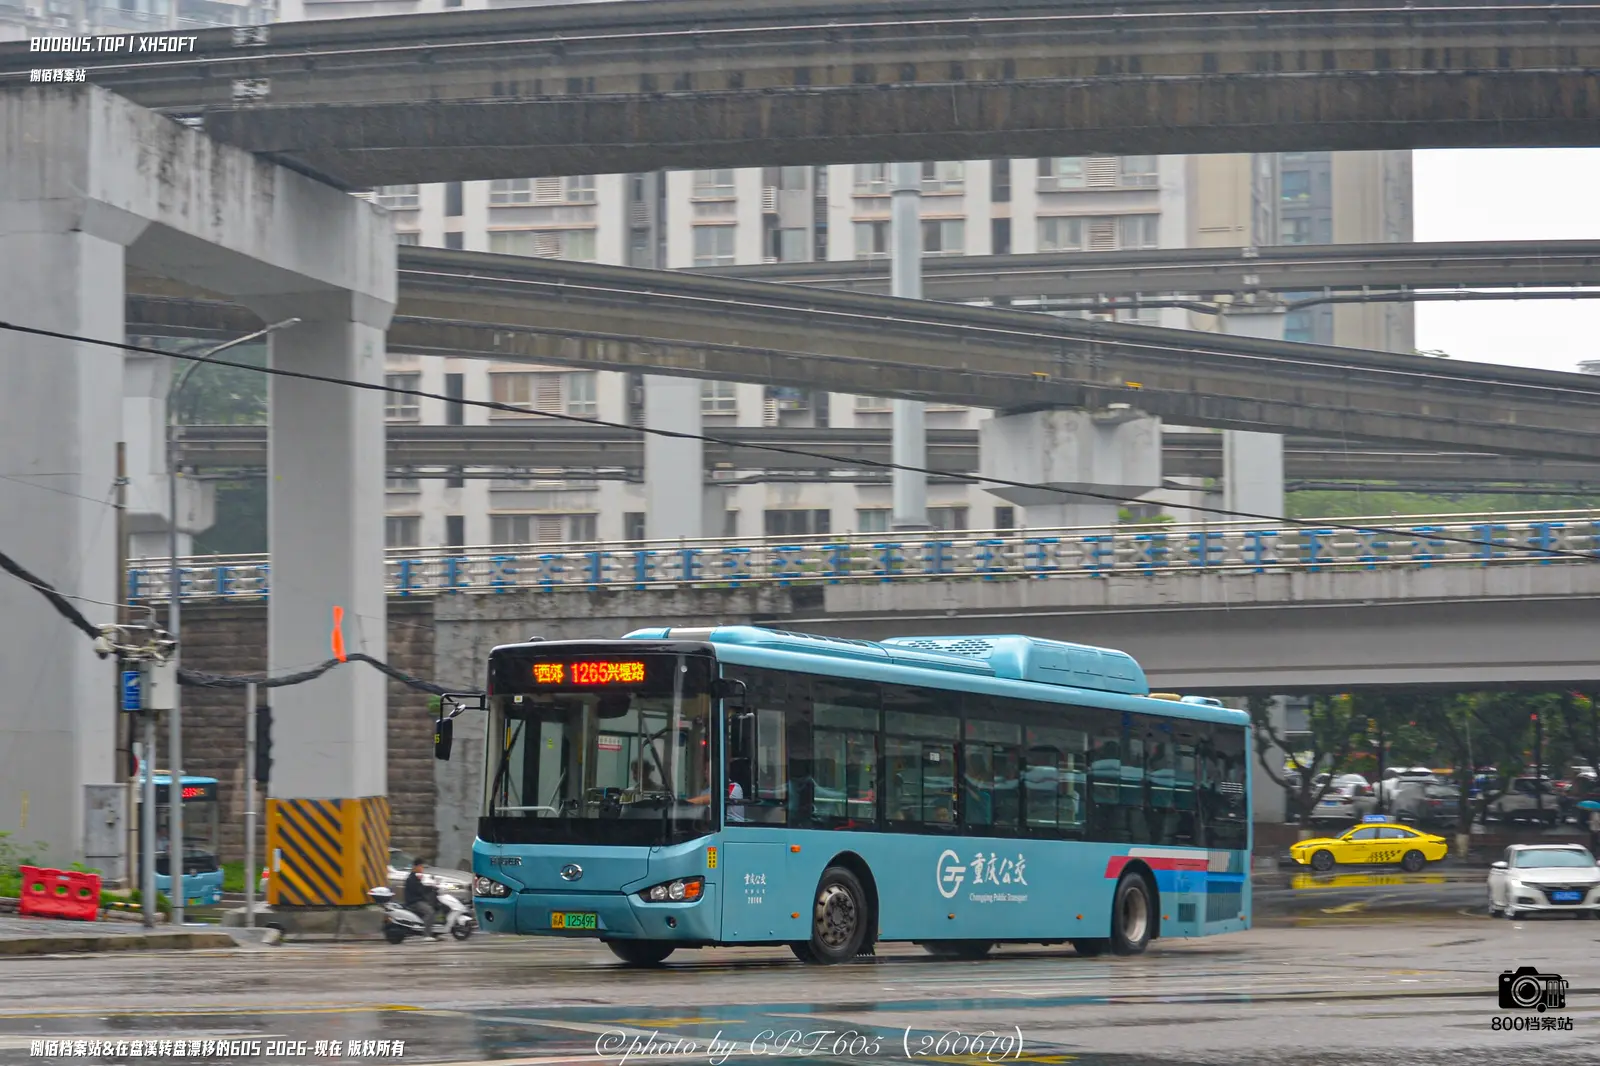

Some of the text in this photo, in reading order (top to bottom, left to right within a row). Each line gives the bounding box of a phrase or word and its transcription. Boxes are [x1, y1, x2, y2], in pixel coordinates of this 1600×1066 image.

[571, 662, 608, 683] 1265
[969, 852, 1028, 886] 重庆公交
[566, 914, 597, 929] 12549F
